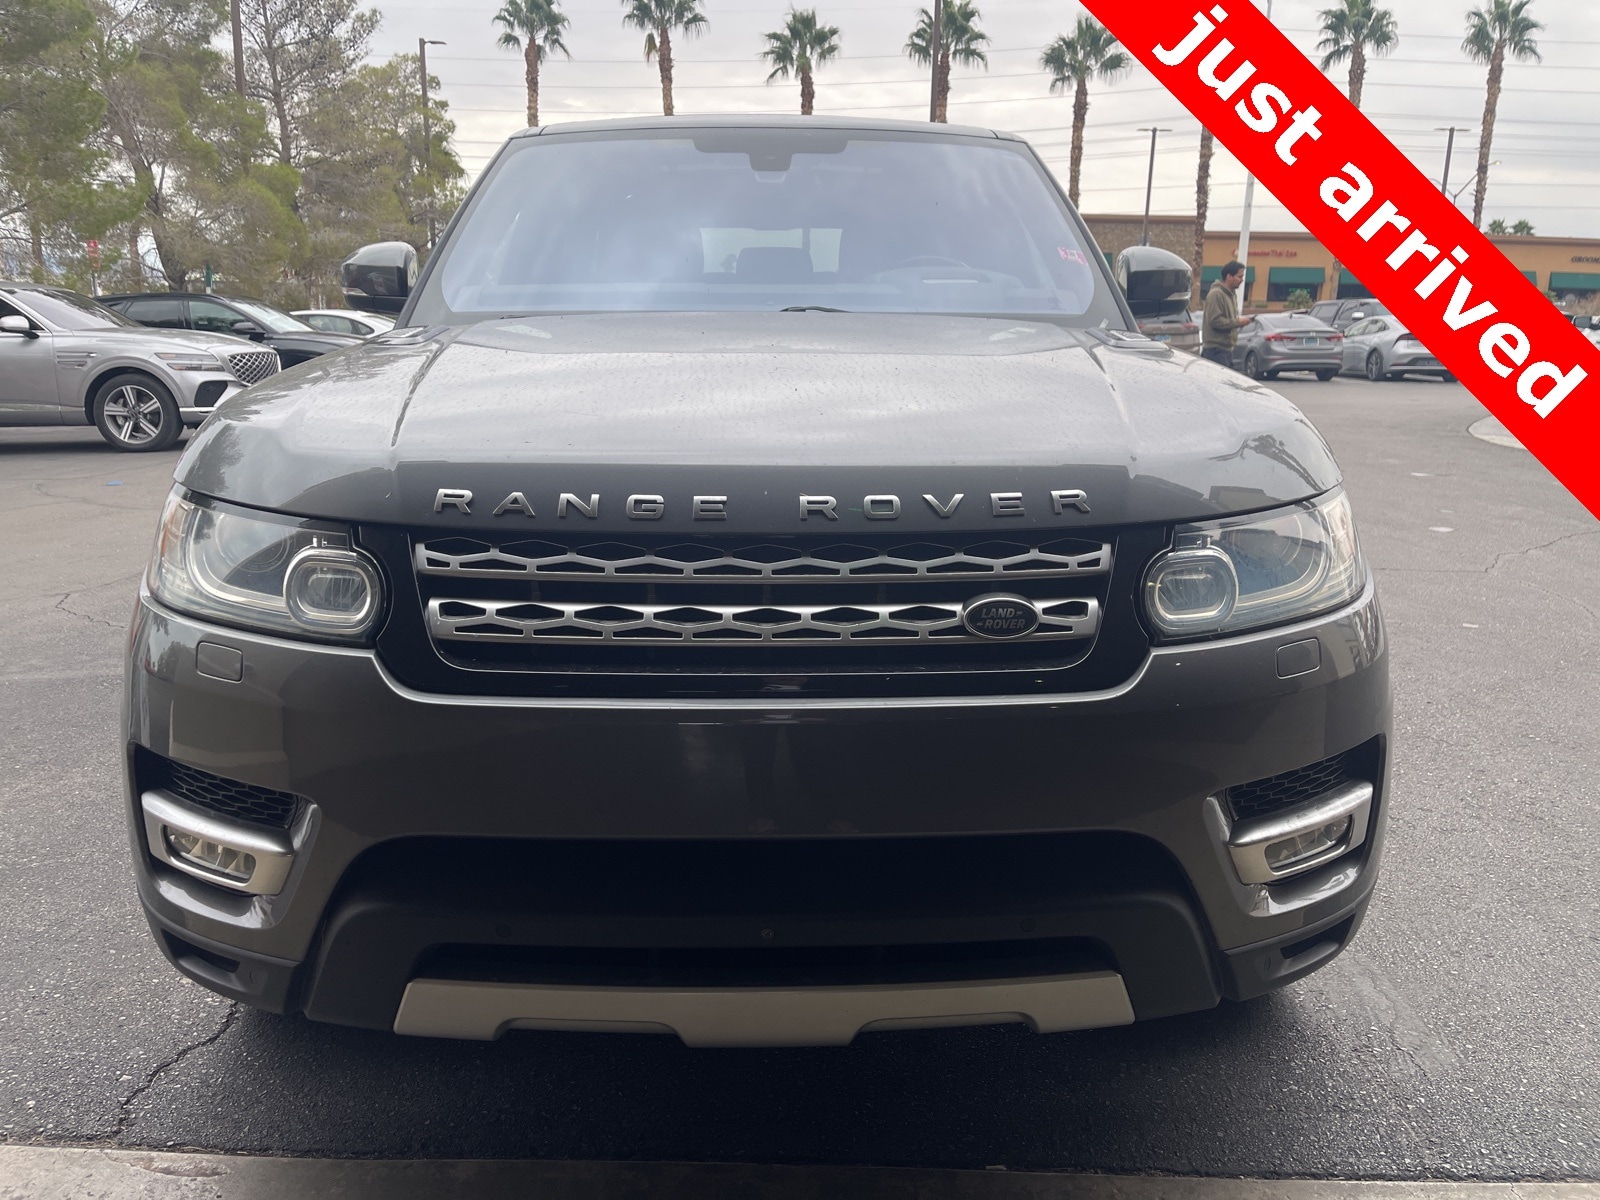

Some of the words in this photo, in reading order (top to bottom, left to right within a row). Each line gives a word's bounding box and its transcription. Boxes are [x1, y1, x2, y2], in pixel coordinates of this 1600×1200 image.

[434, 488, 728, 520] RANGE
[799, 489, 1091, 520] ROVER
[981, 608, 1015, 618] LAND
[983, 619, 1026, 629] ROVER
